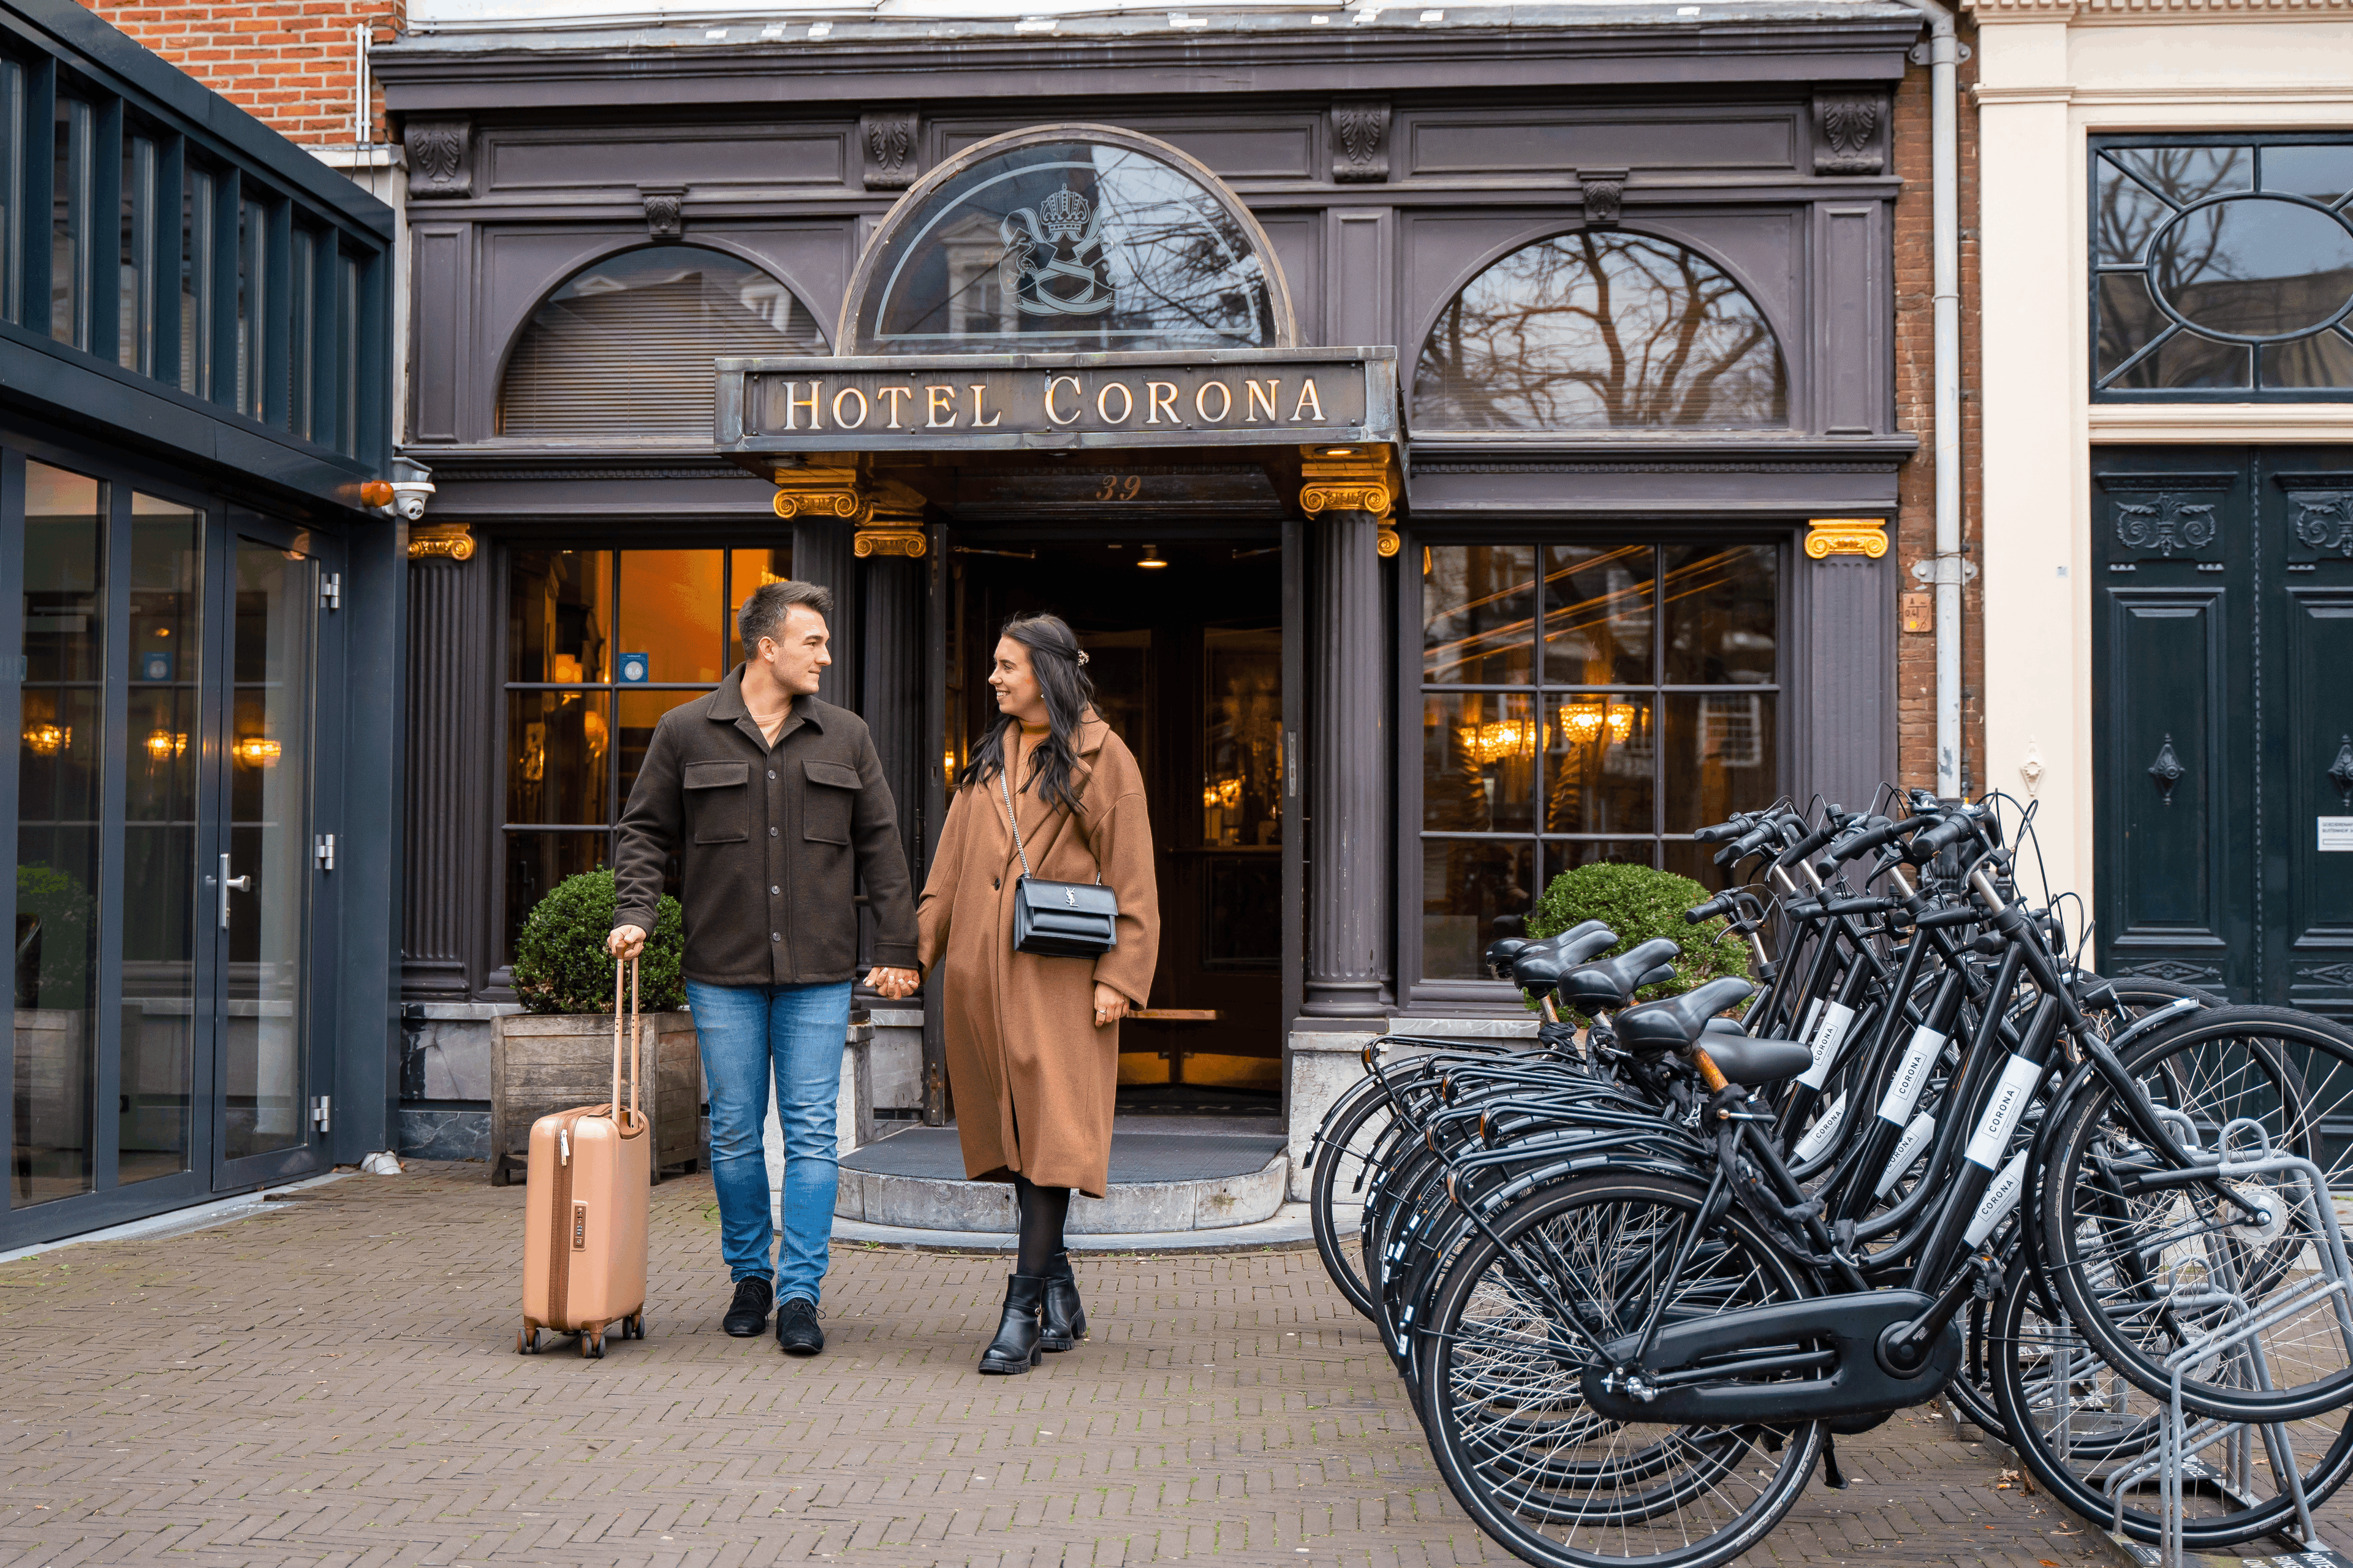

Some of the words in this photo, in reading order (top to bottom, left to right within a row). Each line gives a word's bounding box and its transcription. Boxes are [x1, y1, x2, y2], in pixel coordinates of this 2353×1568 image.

[782, 380, 1002, 431] HOTEL
[1045, 375, 1326, 425] CORONA
[1096, 475, 1141, 501] 39
[1814, 1028, 1833, 1061] CORONA
[1899, 1056, 1921, 1094] CORONA
[1816, 1111, 1841, 1138] CORONA
[1989, 1090, 2015, 1132] CORONA
[1981, 1180, 2014, 1214] CORONA
[2324, 1460, 2351, 1490] SCHWALBE
